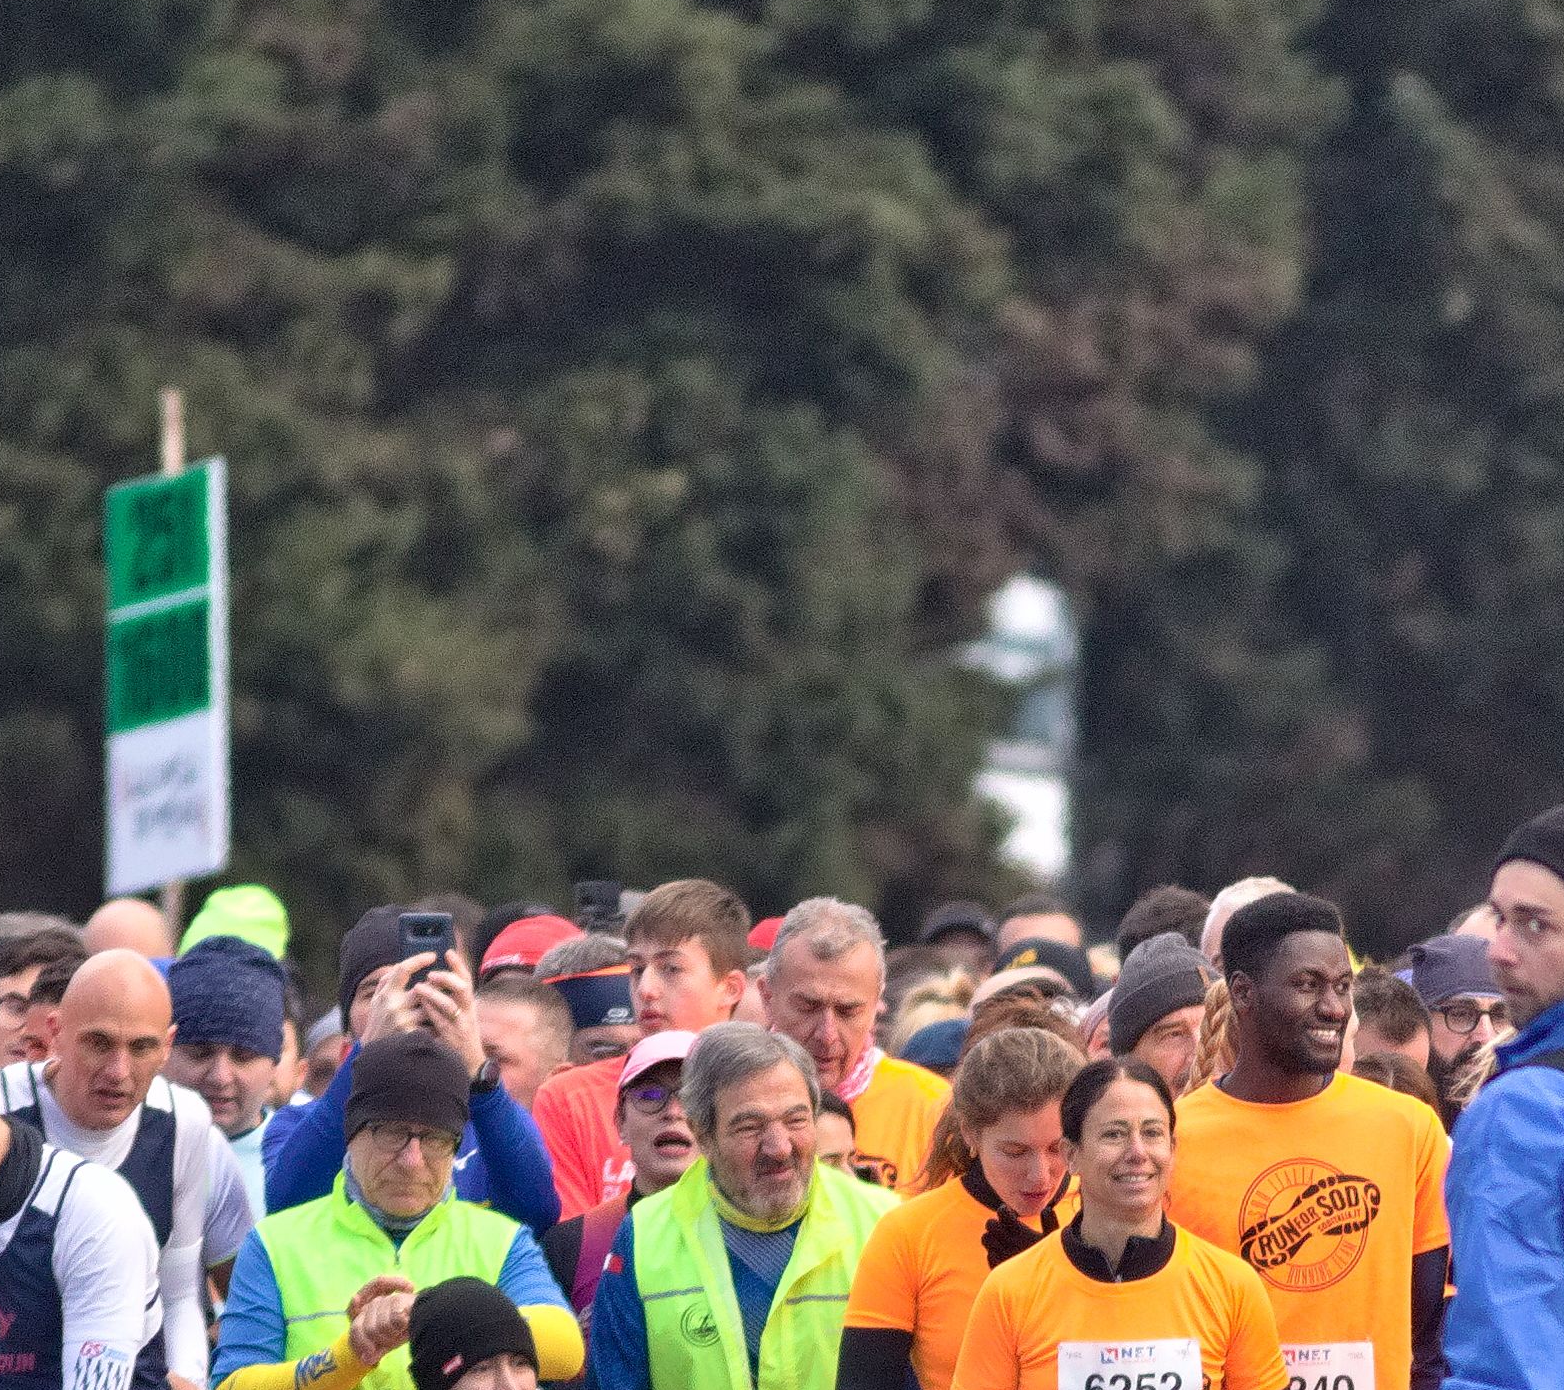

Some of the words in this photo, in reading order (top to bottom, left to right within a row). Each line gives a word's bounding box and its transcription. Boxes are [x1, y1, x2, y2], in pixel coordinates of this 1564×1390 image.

[1257, 1218, 1301, 1258] RUN
[1293, 1206, 1321, 1233] FOR
[1316, 1185, 1360, 1218] SOD
